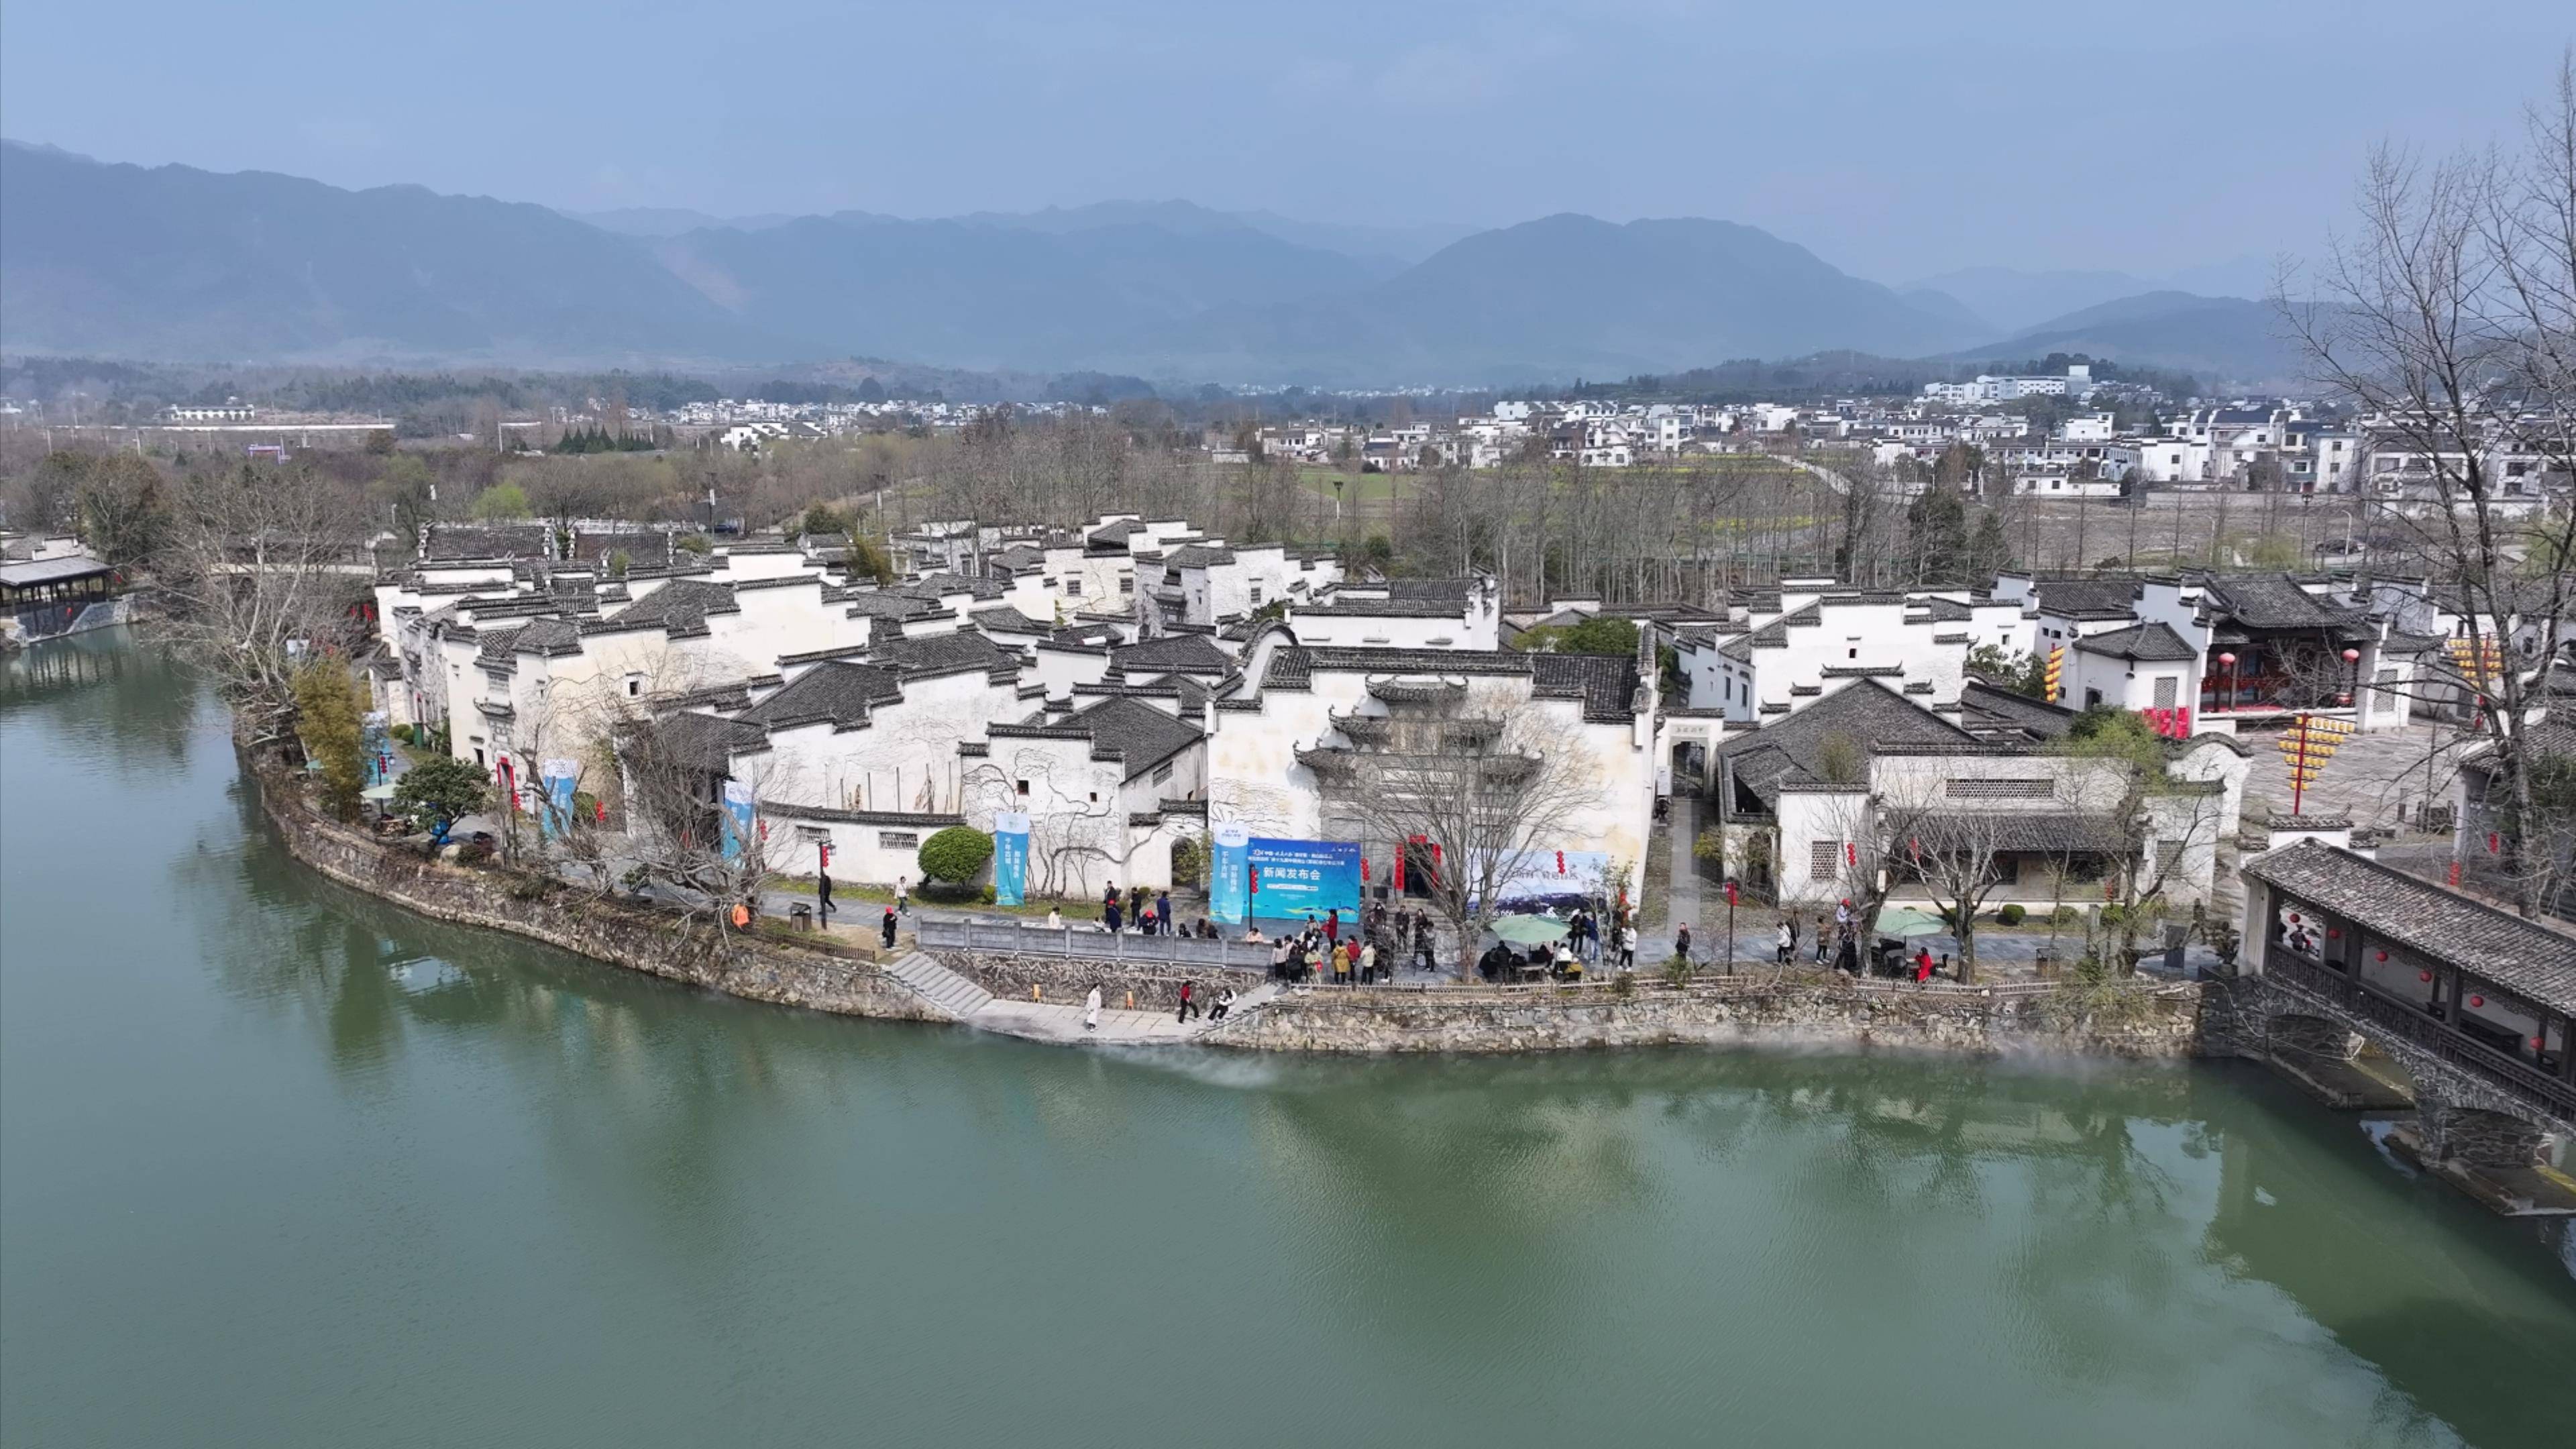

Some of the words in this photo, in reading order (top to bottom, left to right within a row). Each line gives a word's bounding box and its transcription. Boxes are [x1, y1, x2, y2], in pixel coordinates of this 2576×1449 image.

[1263, 867, 1321, 880] 新闻发布会
